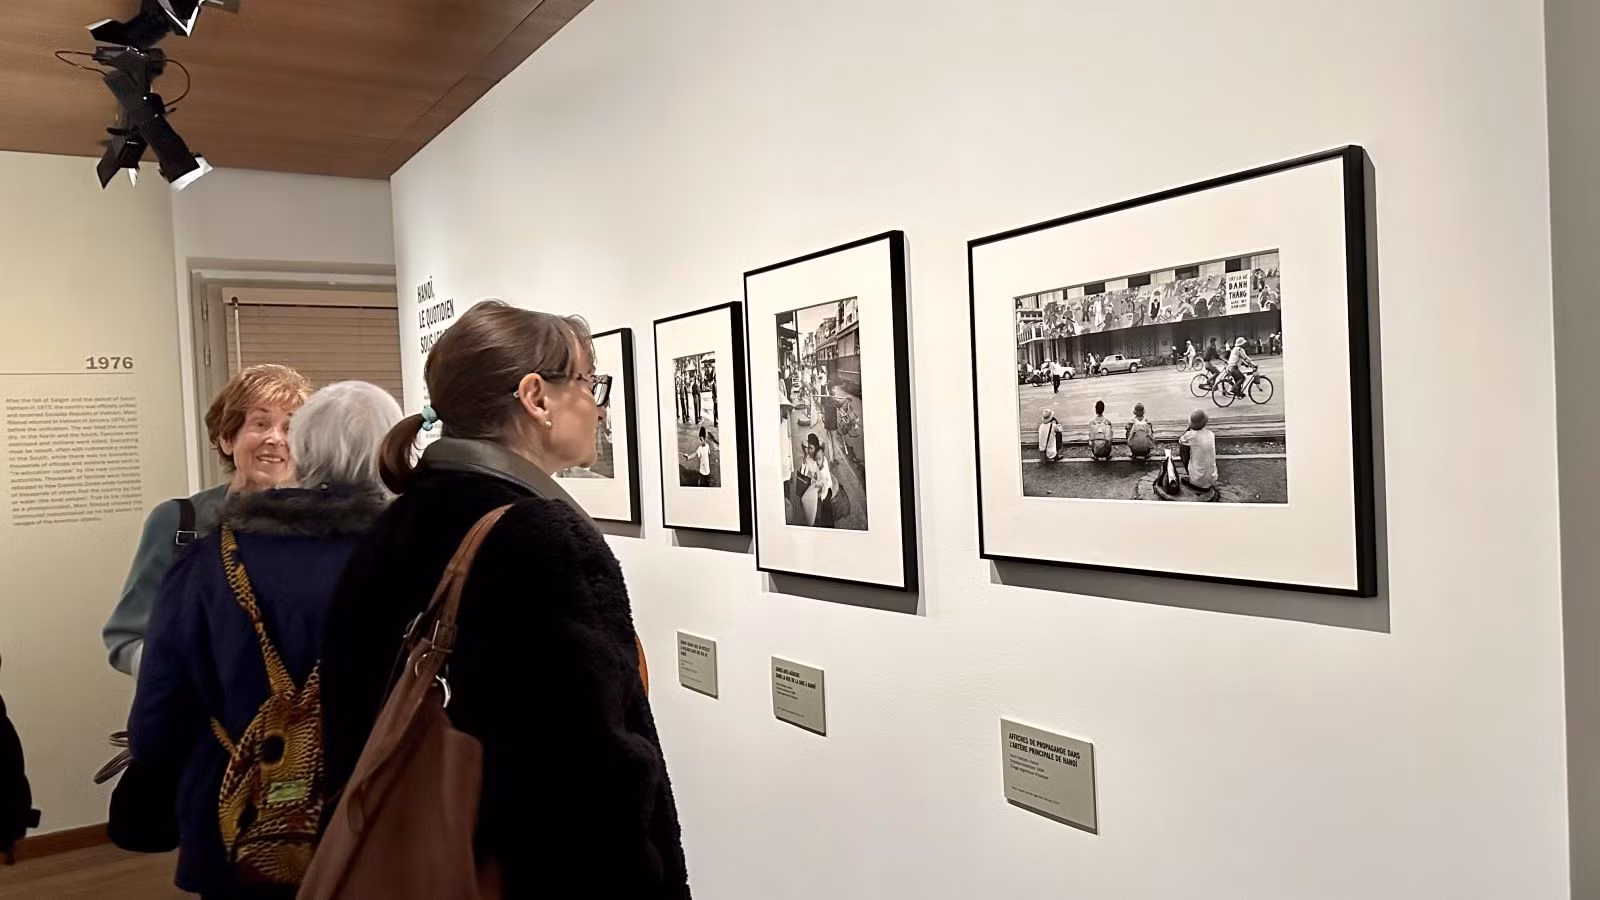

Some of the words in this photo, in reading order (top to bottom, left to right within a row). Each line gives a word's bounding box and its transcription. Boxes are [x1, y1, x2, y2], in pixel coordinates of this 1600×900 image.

[419, 310, 425, 329] LE
[426, 298, 455, 329] QUOTIDIEN
[86, 356, 134, 370] 1976
[1009, 732, 1029, 745] AFFICHES
[1029, 738, 1036, 747] DE
[1036, 740, 1067, 756] PROPAGANDE
[1067, 749, 1080, 760] DANS
[1028, 746, 1055, 761] PRINCIPALE
[1055, 754, 1062, 763] DE
